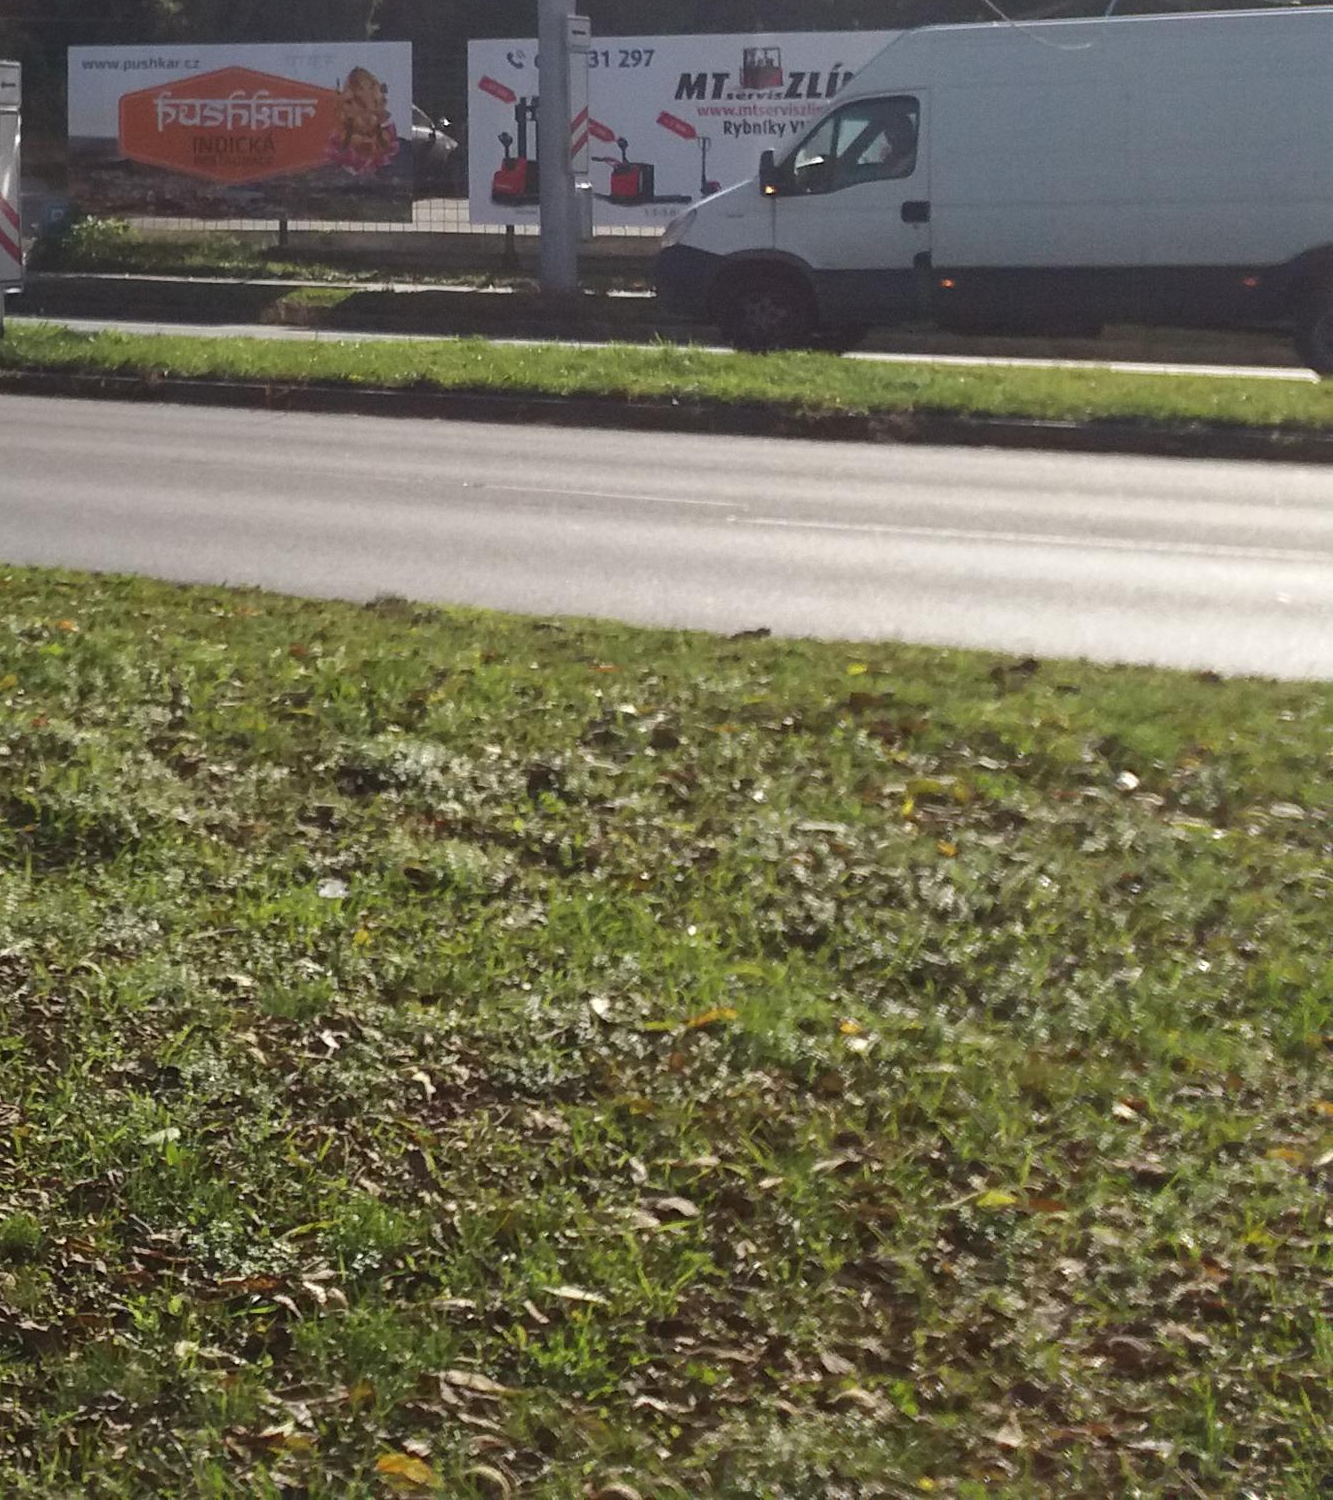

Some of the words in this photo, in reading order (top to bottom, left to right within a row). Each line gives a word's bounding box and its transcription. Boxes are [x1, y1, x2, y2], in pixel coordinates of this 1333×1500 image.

[617, 48, 655, 69] 297
[674, 72, 731, 100] MT
[723, 119, 786, 138] Rybníky
[192, 130, 277, 155] INDICKÁ
